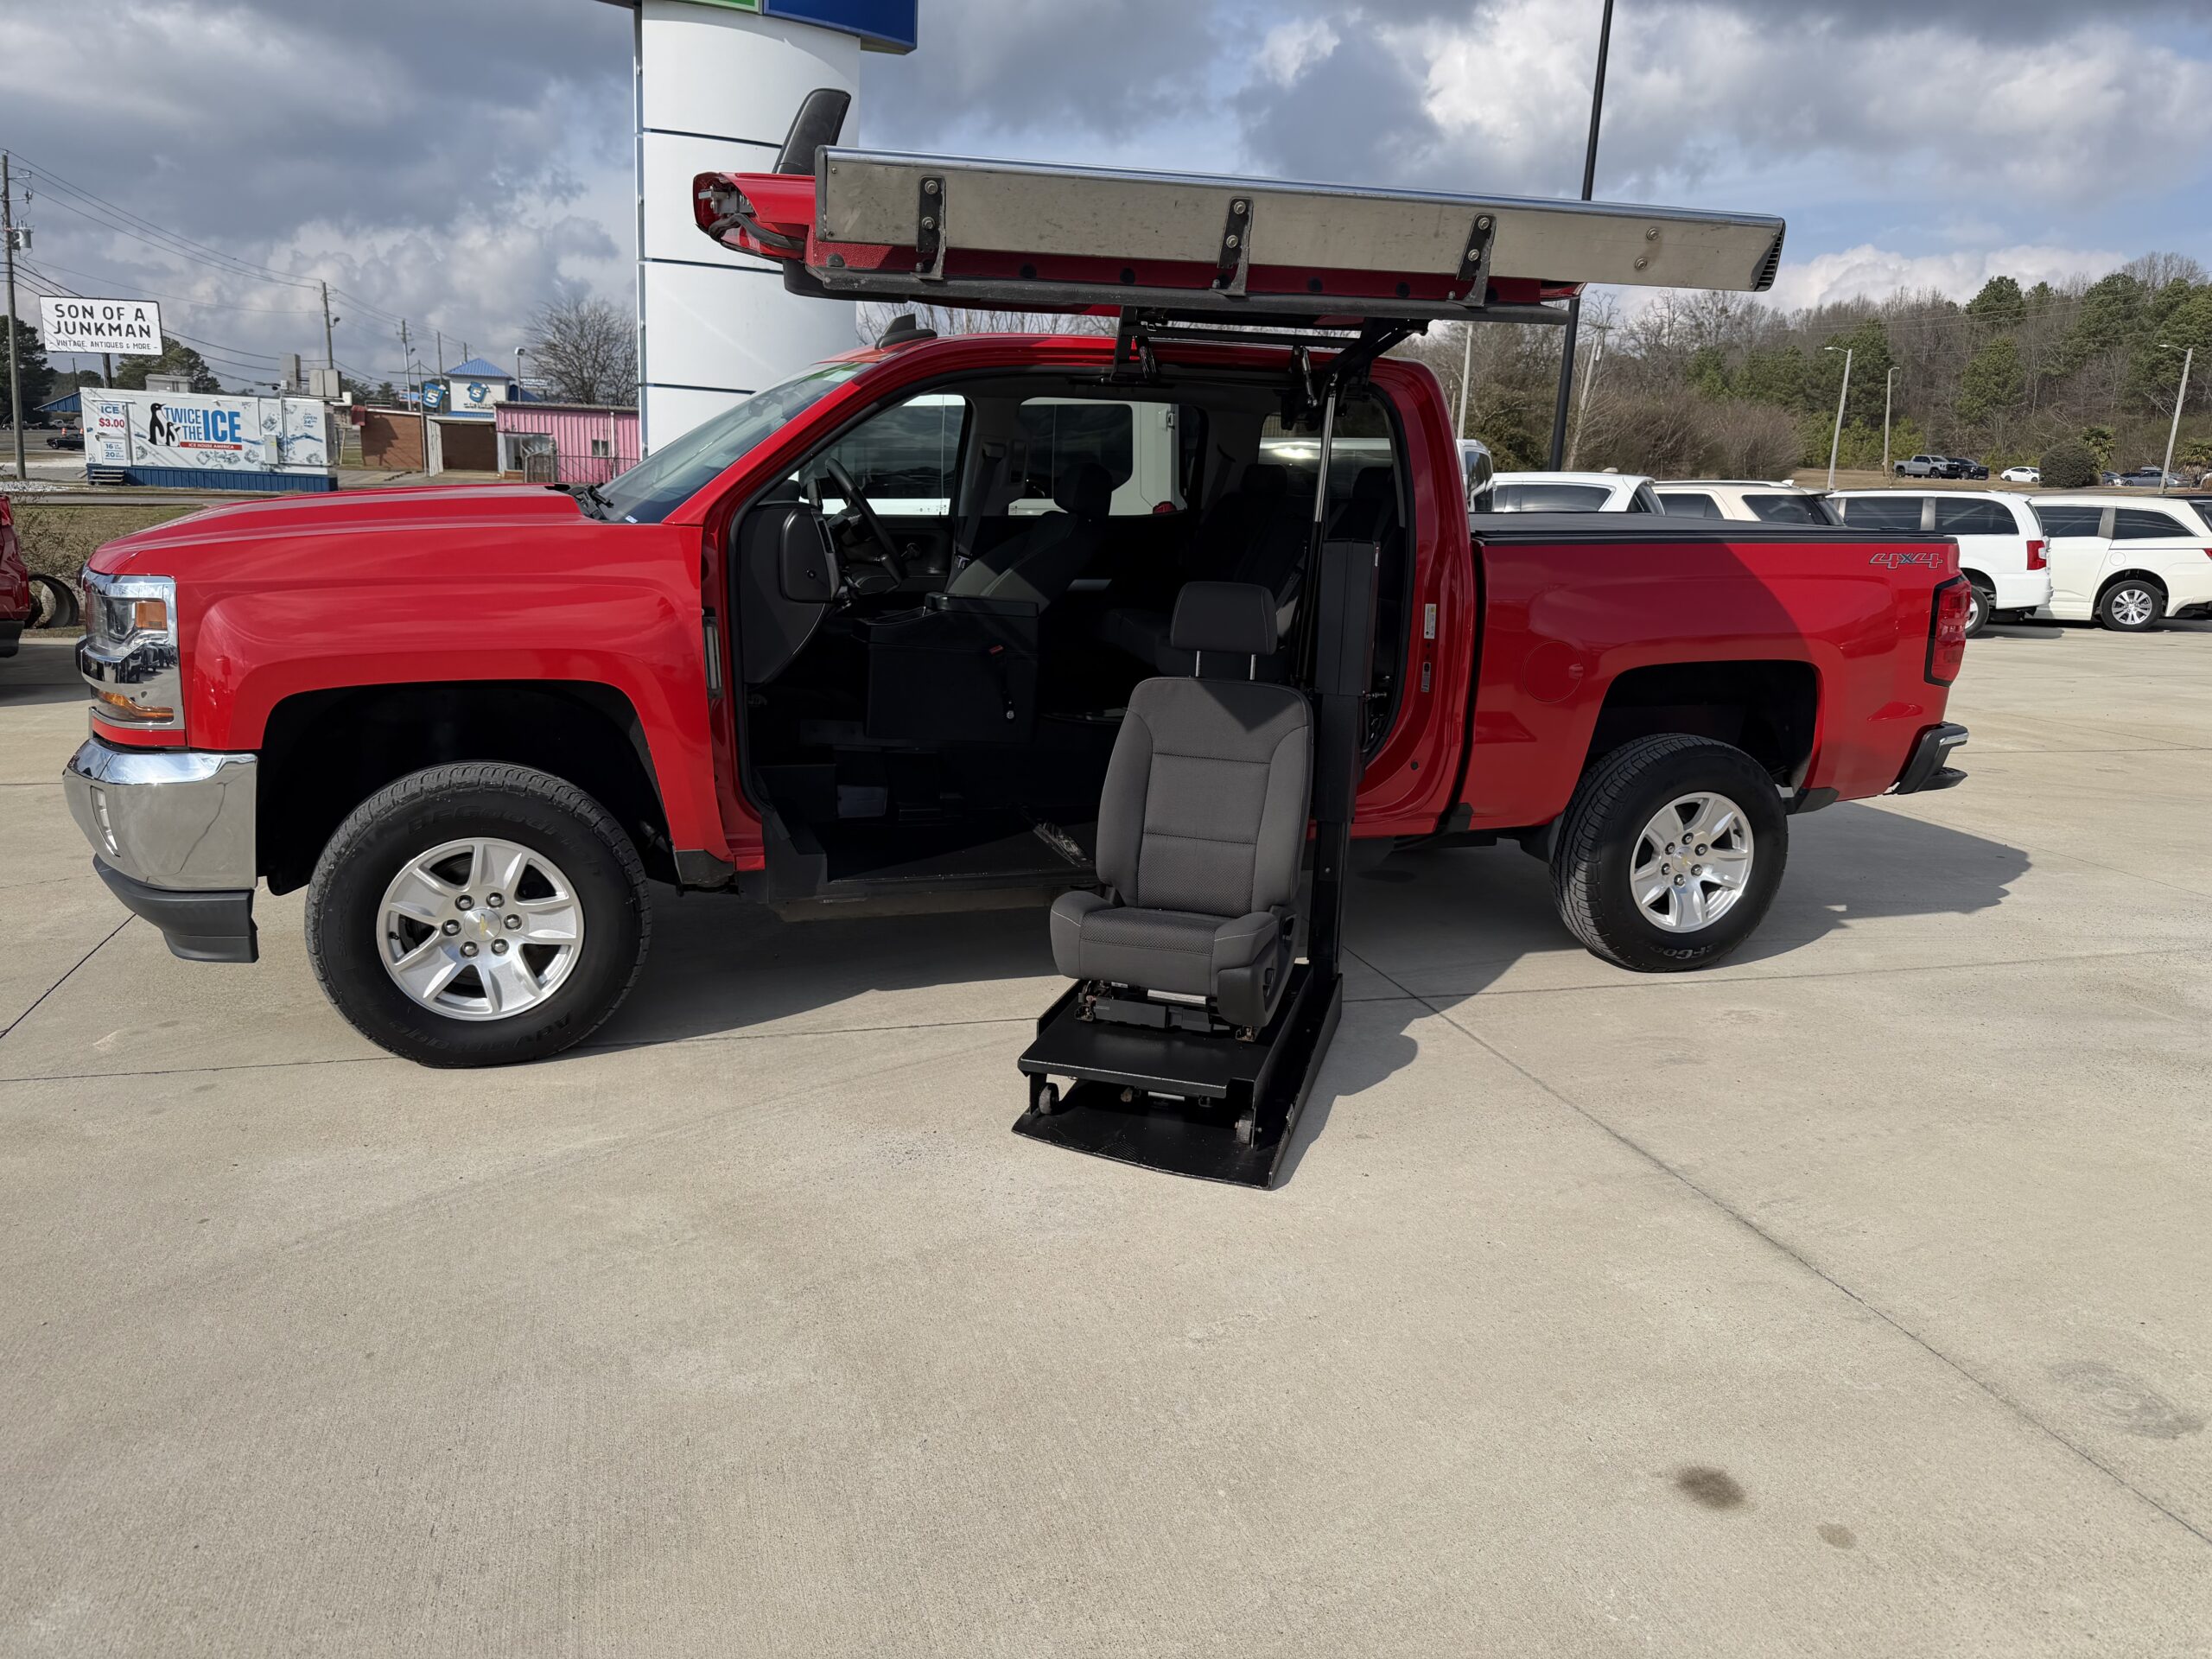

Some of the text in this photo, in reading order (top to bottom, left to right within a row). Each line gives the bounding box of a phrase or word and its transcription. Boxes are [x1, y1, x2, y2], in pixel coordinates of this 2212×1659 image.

[54, 303, 146, 322] SON OF A
[54, 321, 151, 338] JUNKMAN
[90, 340, 124, 349] ANTIQUES
[100, 405, 119, 414] ICE
[163, 407, 201, 424] TWICE
[99, 417, 125, 428] $3.00
[202, 410, 242, 442] ICE
[181, 425, 203, 441] THE
